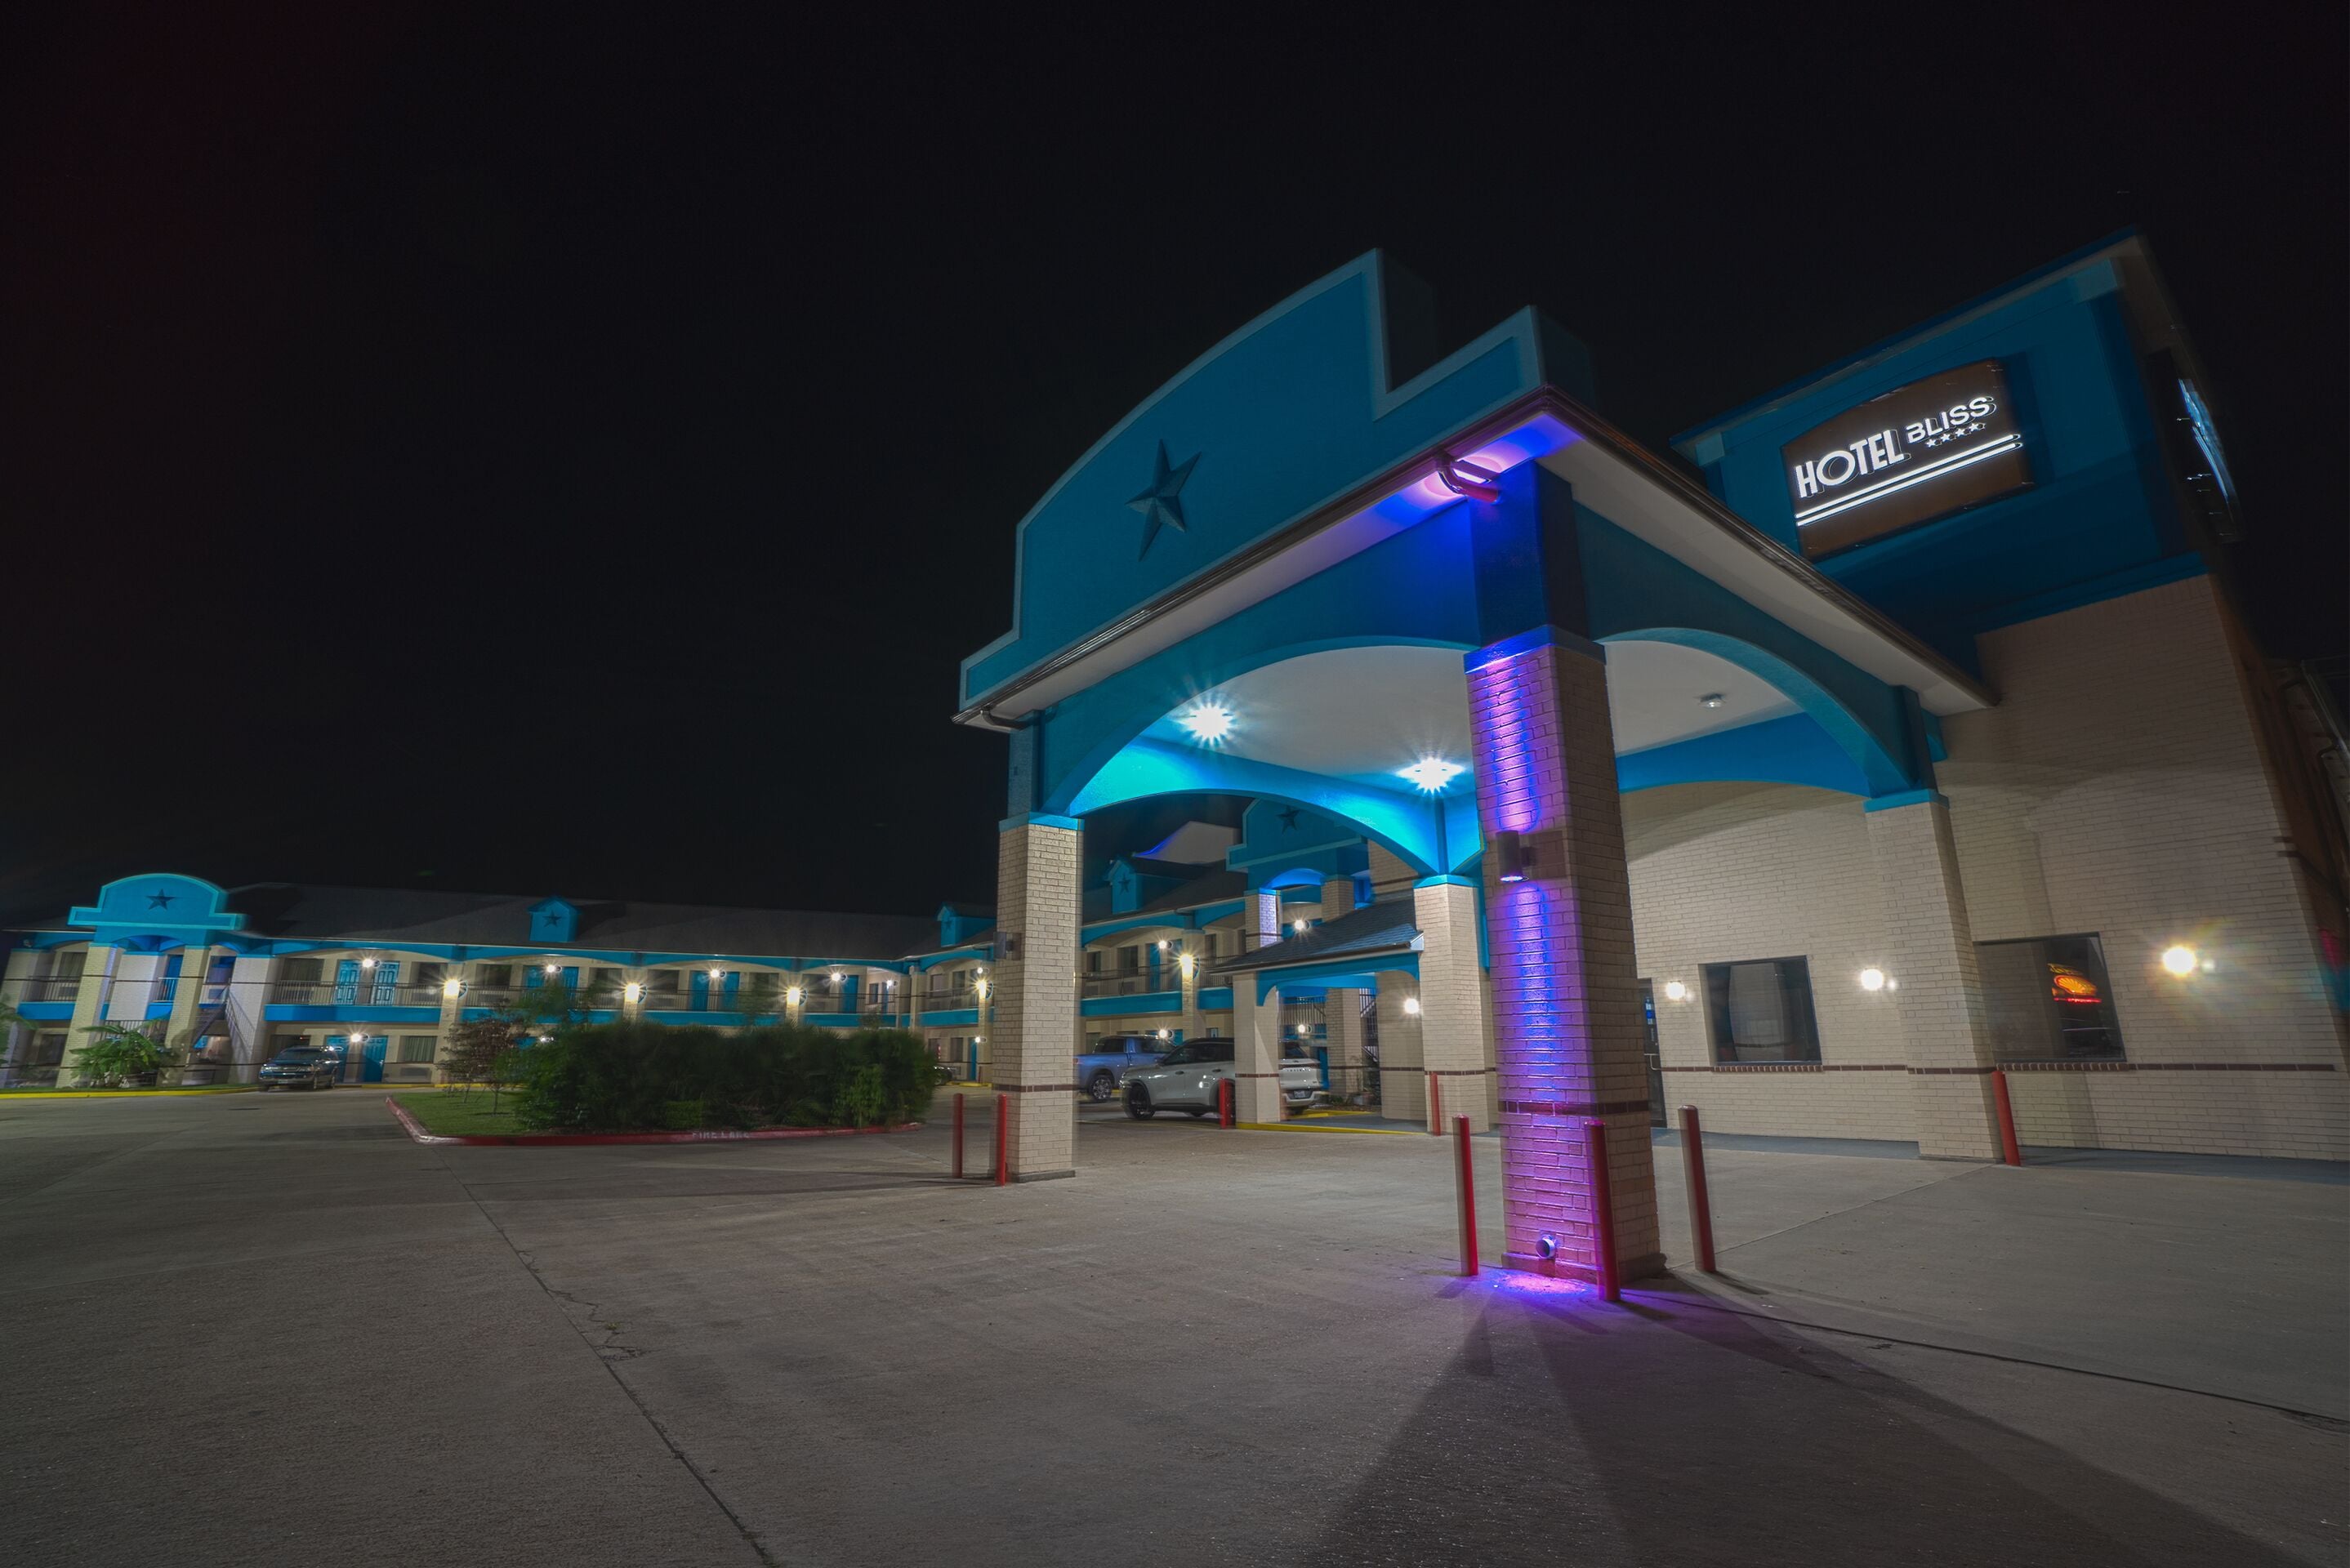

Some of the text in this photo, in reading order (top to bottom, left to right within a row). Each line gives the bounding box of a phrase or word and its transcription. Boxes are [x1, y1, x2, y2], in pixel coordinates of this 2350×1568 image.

[1795, 396, 1994, 498] HOTEL BLISS
[692, 1131, 717, 1139] FIRE
